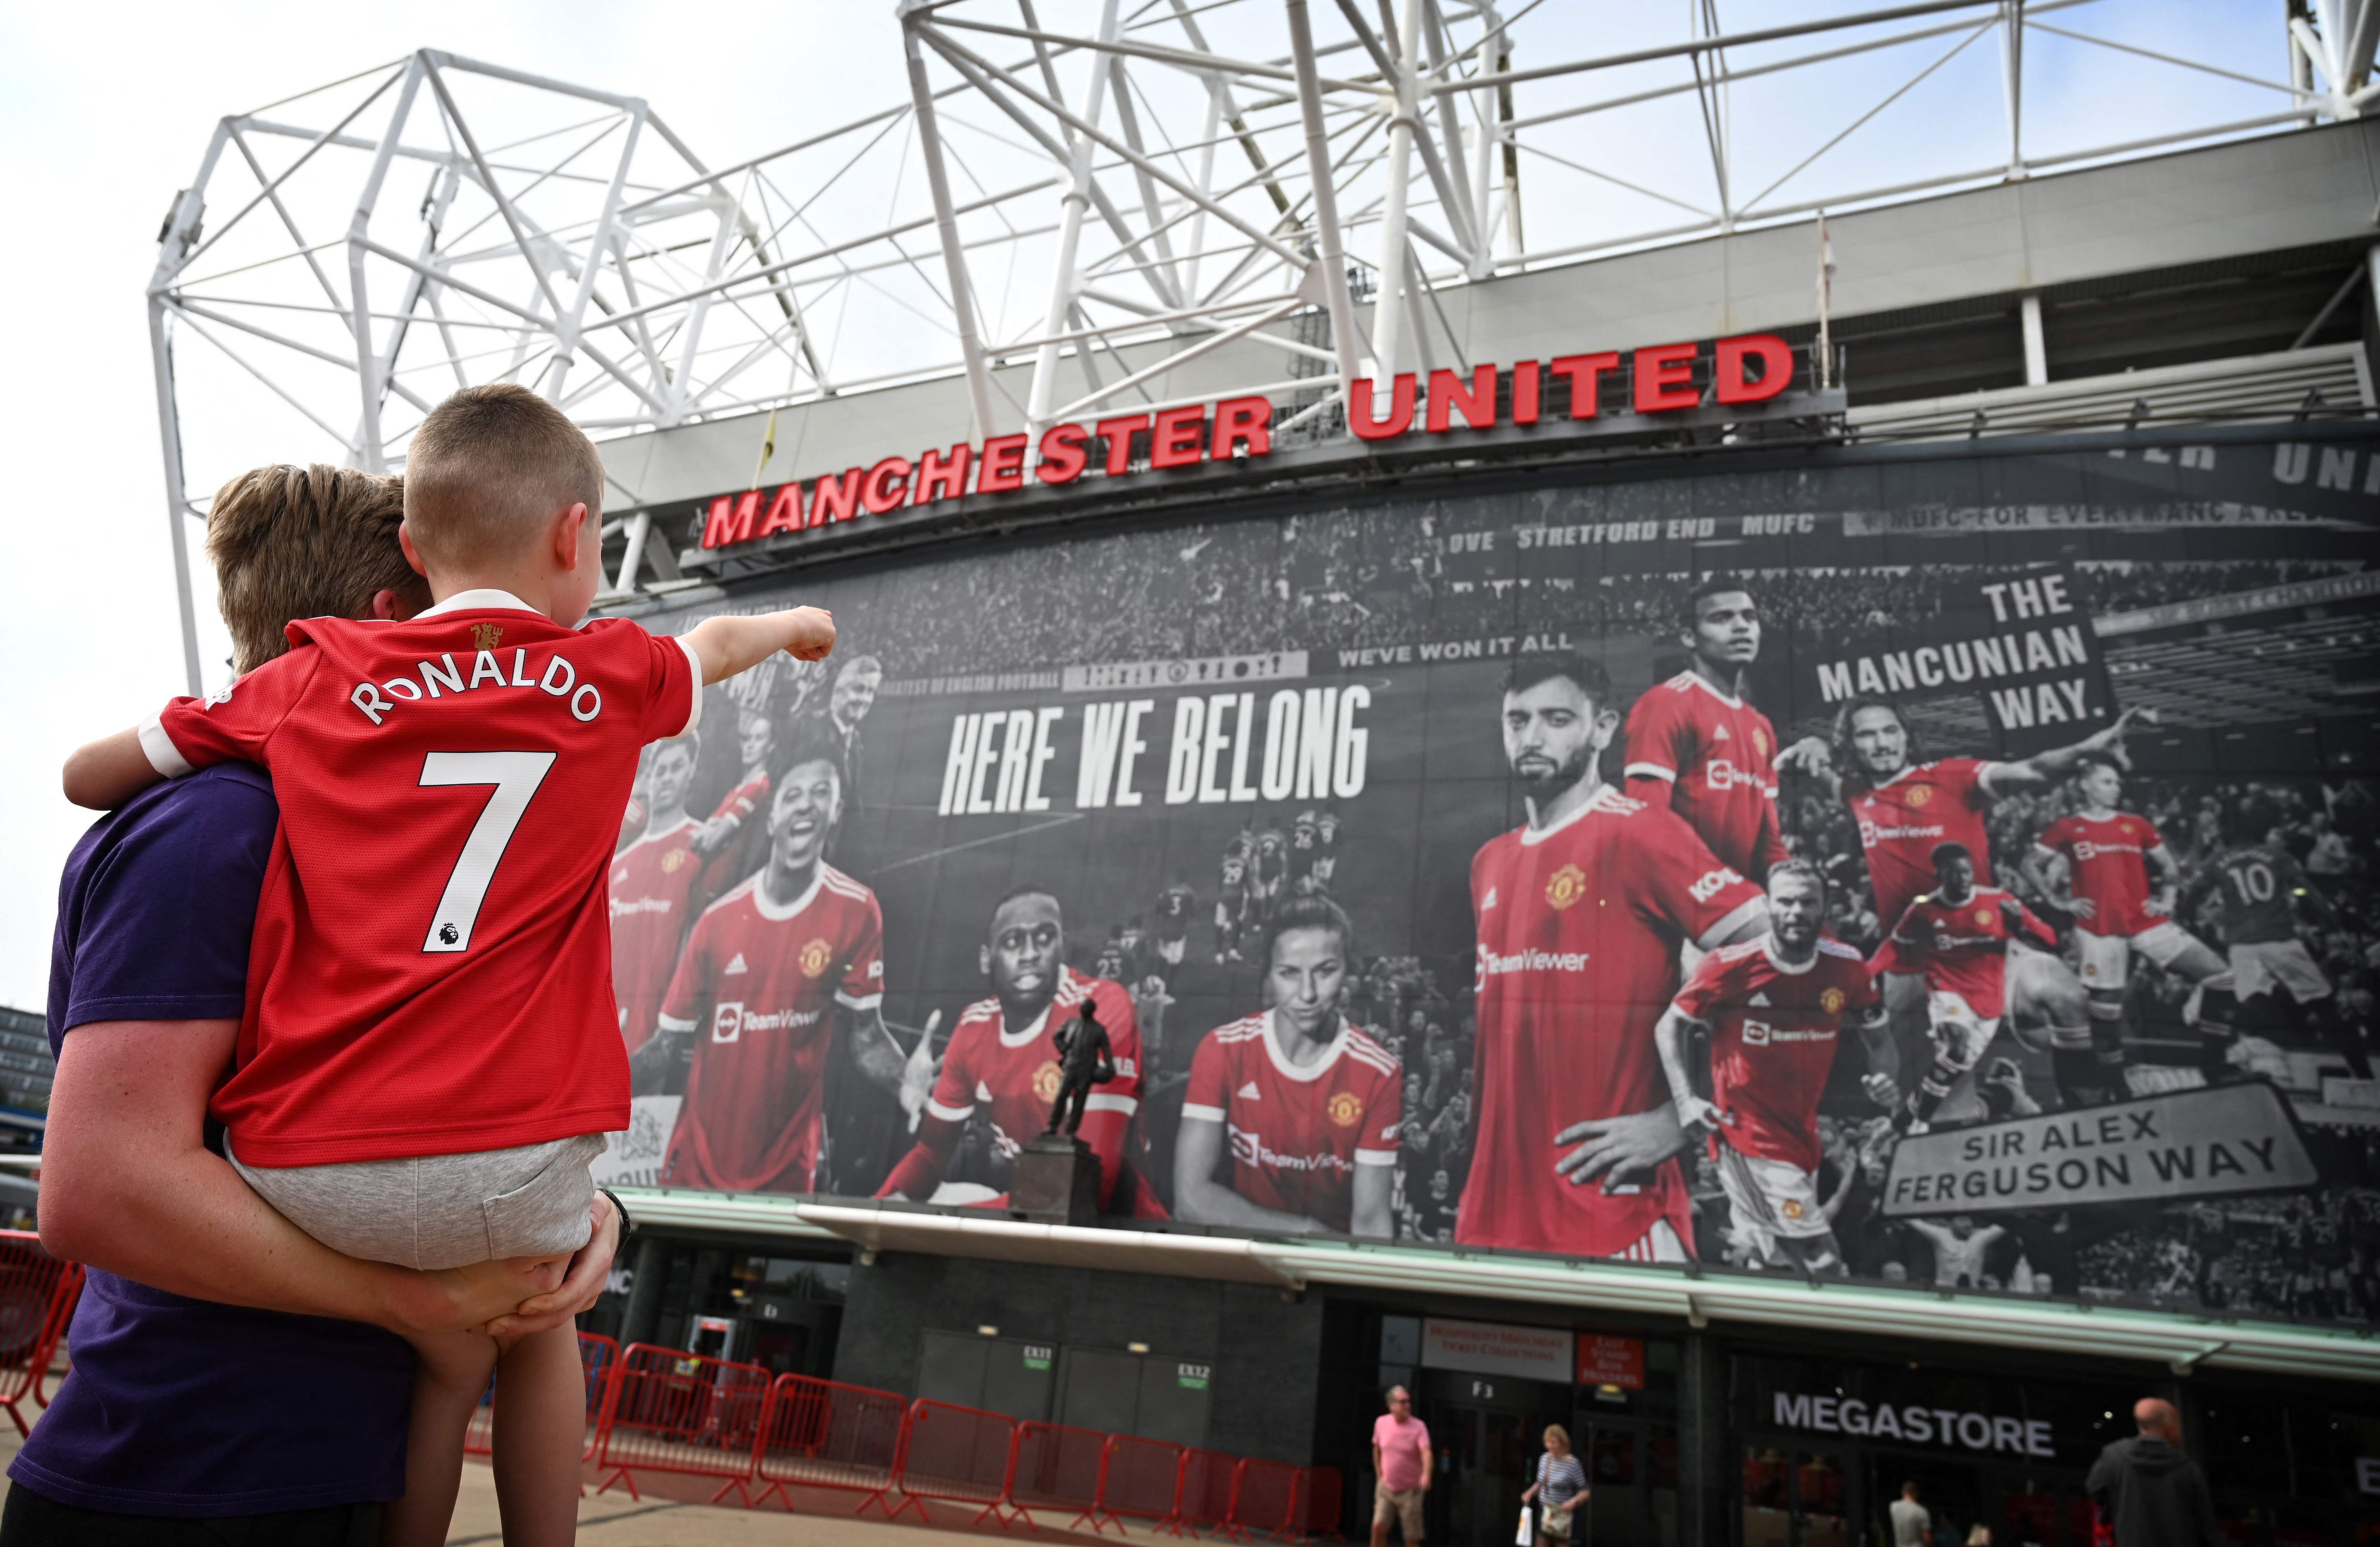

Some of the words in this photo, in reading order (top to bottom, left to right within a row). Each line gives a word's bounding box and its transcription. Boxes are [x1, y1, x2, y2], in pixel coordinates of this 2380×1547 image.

[702, 395, 1273, 549] MANCHESTER
[1346, 335, 1795, 440] UNITED
[1517, 520, 1658, 549] STRETFORD
[1666, 518, 1716, 540] END
[1741, 514, 1815, 536] MUFC
[1981, 574, 2073, 622] THE
[1419, 640, 1481, 662] WON
[1488, 637, 1515, 654] IT
[1520, 632, 1574, 652] ALL
[1816, 625, 2088, 702] MANCUNIAN
[350, 648, 602, 726] RONALDO
[1990, 678, 2106, 729] WAY.
[937, 706, 1064, 816] HERE
[1075, 700, 1154, 808] WE
[1164, 685, 1371, 804] BELONG
[417, 751, 558, 954] 7
[2226, 862, 2275, 905] 10
[1486, 948, 1589, 974] TeamViewer
[1962, 1131, 2025, 1161] SIR
[2041, 1110, 2160, 1152] ALEX
[1893, 1153, 2131, 1203] FERGUSON
[2148, 1136, 2276, 1181] WAY
[1774, 1391, 2056, 1456] MEGASTORE
